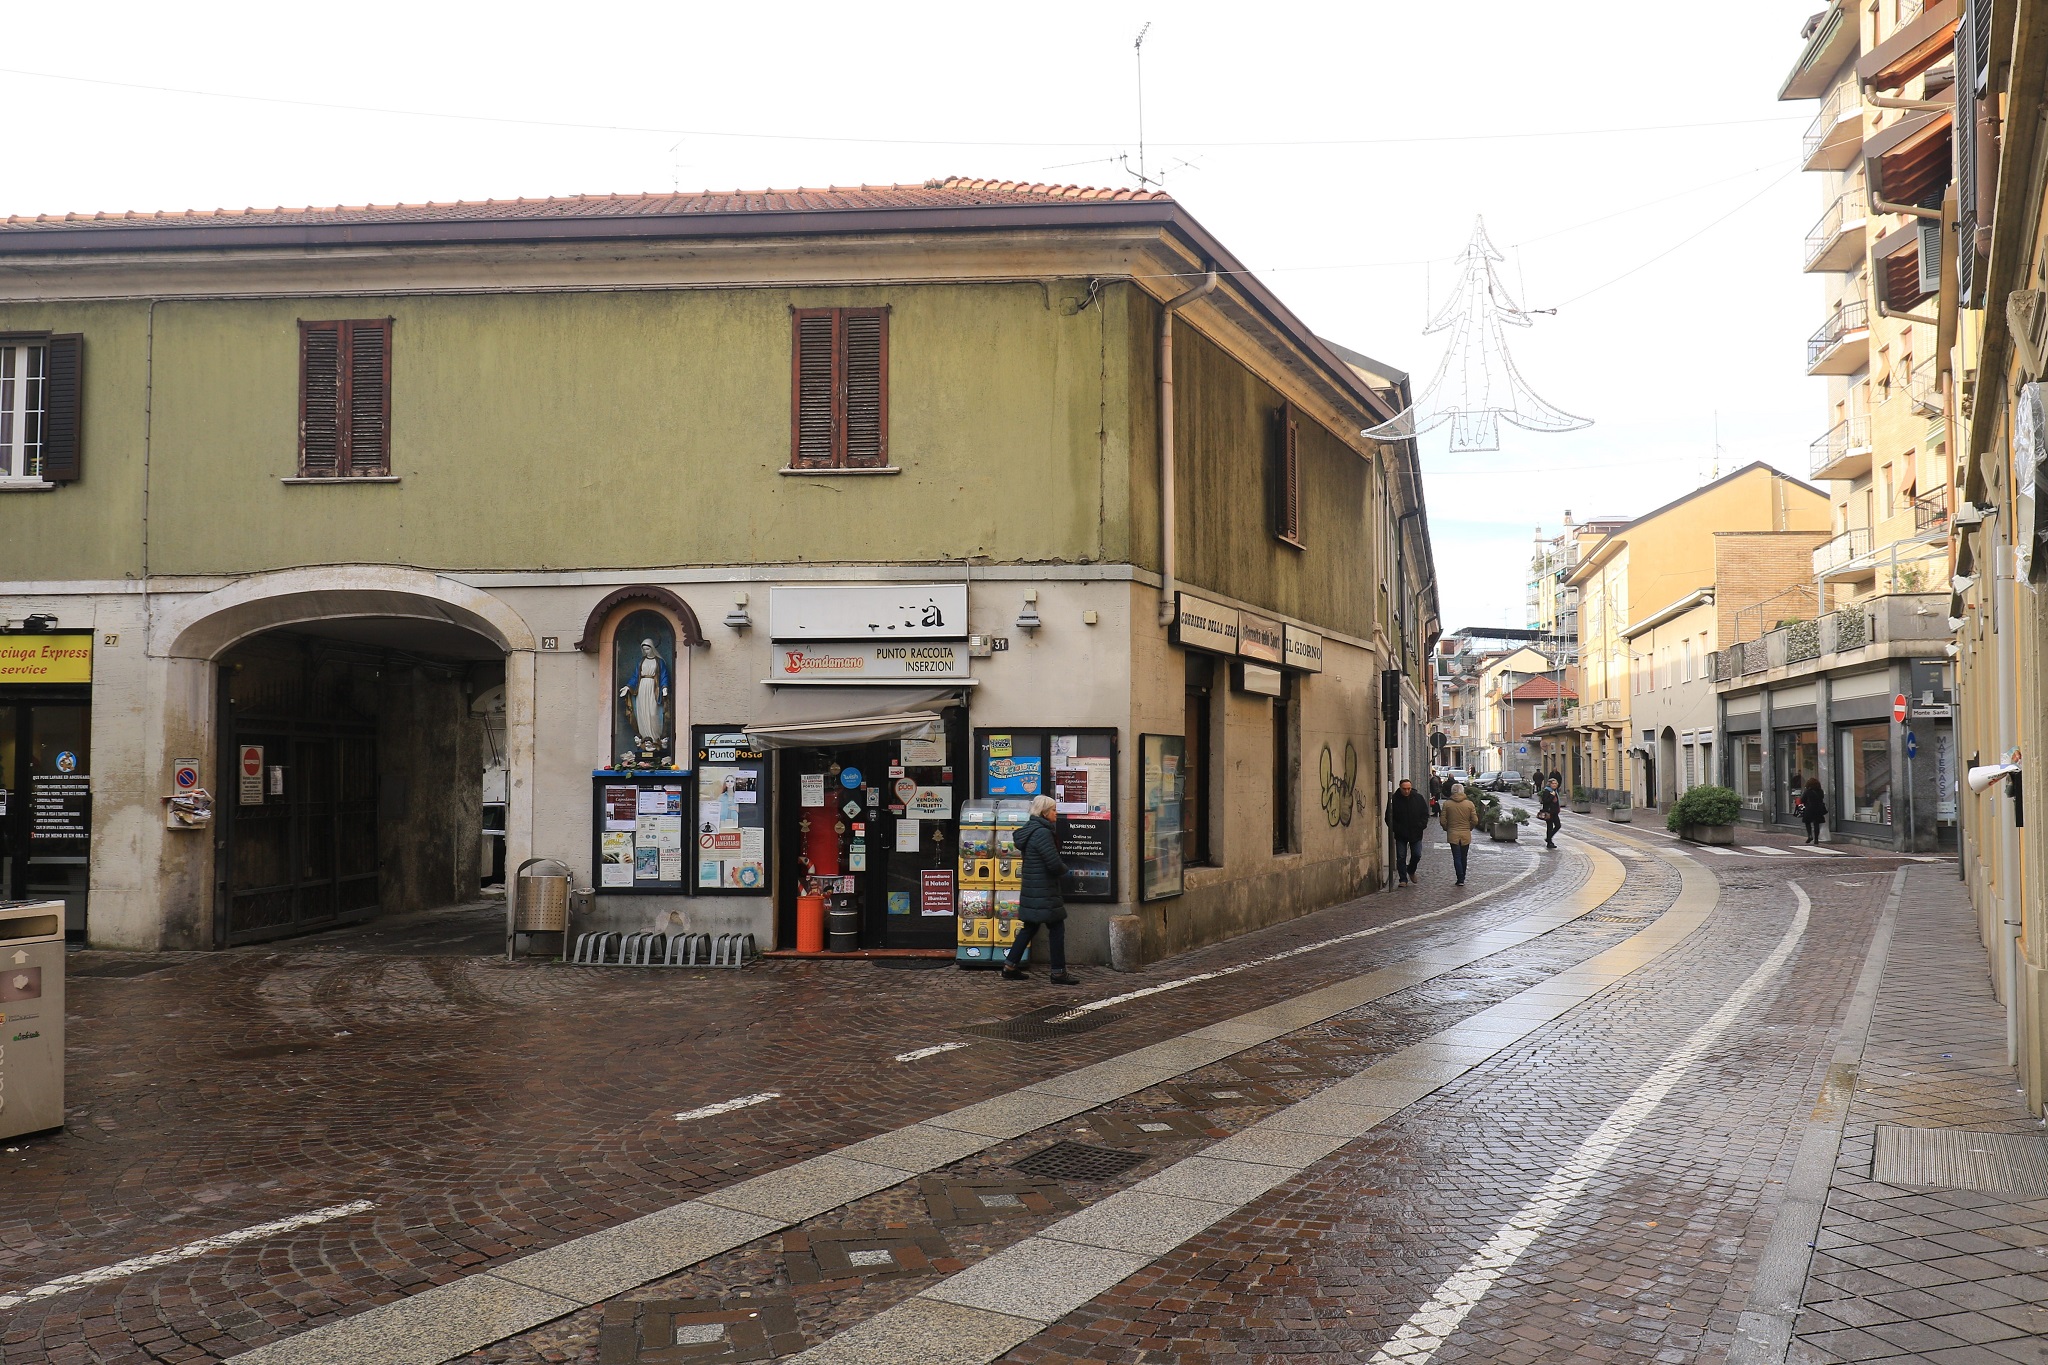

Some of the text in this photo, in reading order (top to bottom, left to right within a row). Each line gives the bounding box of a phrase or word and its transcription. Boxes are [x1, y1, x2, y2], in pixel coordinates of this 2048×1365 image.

[1180, 612, 1236, 638] CORRIERE DELLA SERA
[104, 636, 117, 645] 27
[544, 638, 555, 648] 29
[994, 640, 1006, 650] 31
[41, 646, 88, 661] Express
[876, 648, 954, 659] PUNTO RACCOLTA
[1286, 638, 1320, 660] IL GIORNO
[785, 652, 864, 674] Secondamano
[905, 661, 954, 672] INSERZIONI
[1, 665, 48, 674] service
